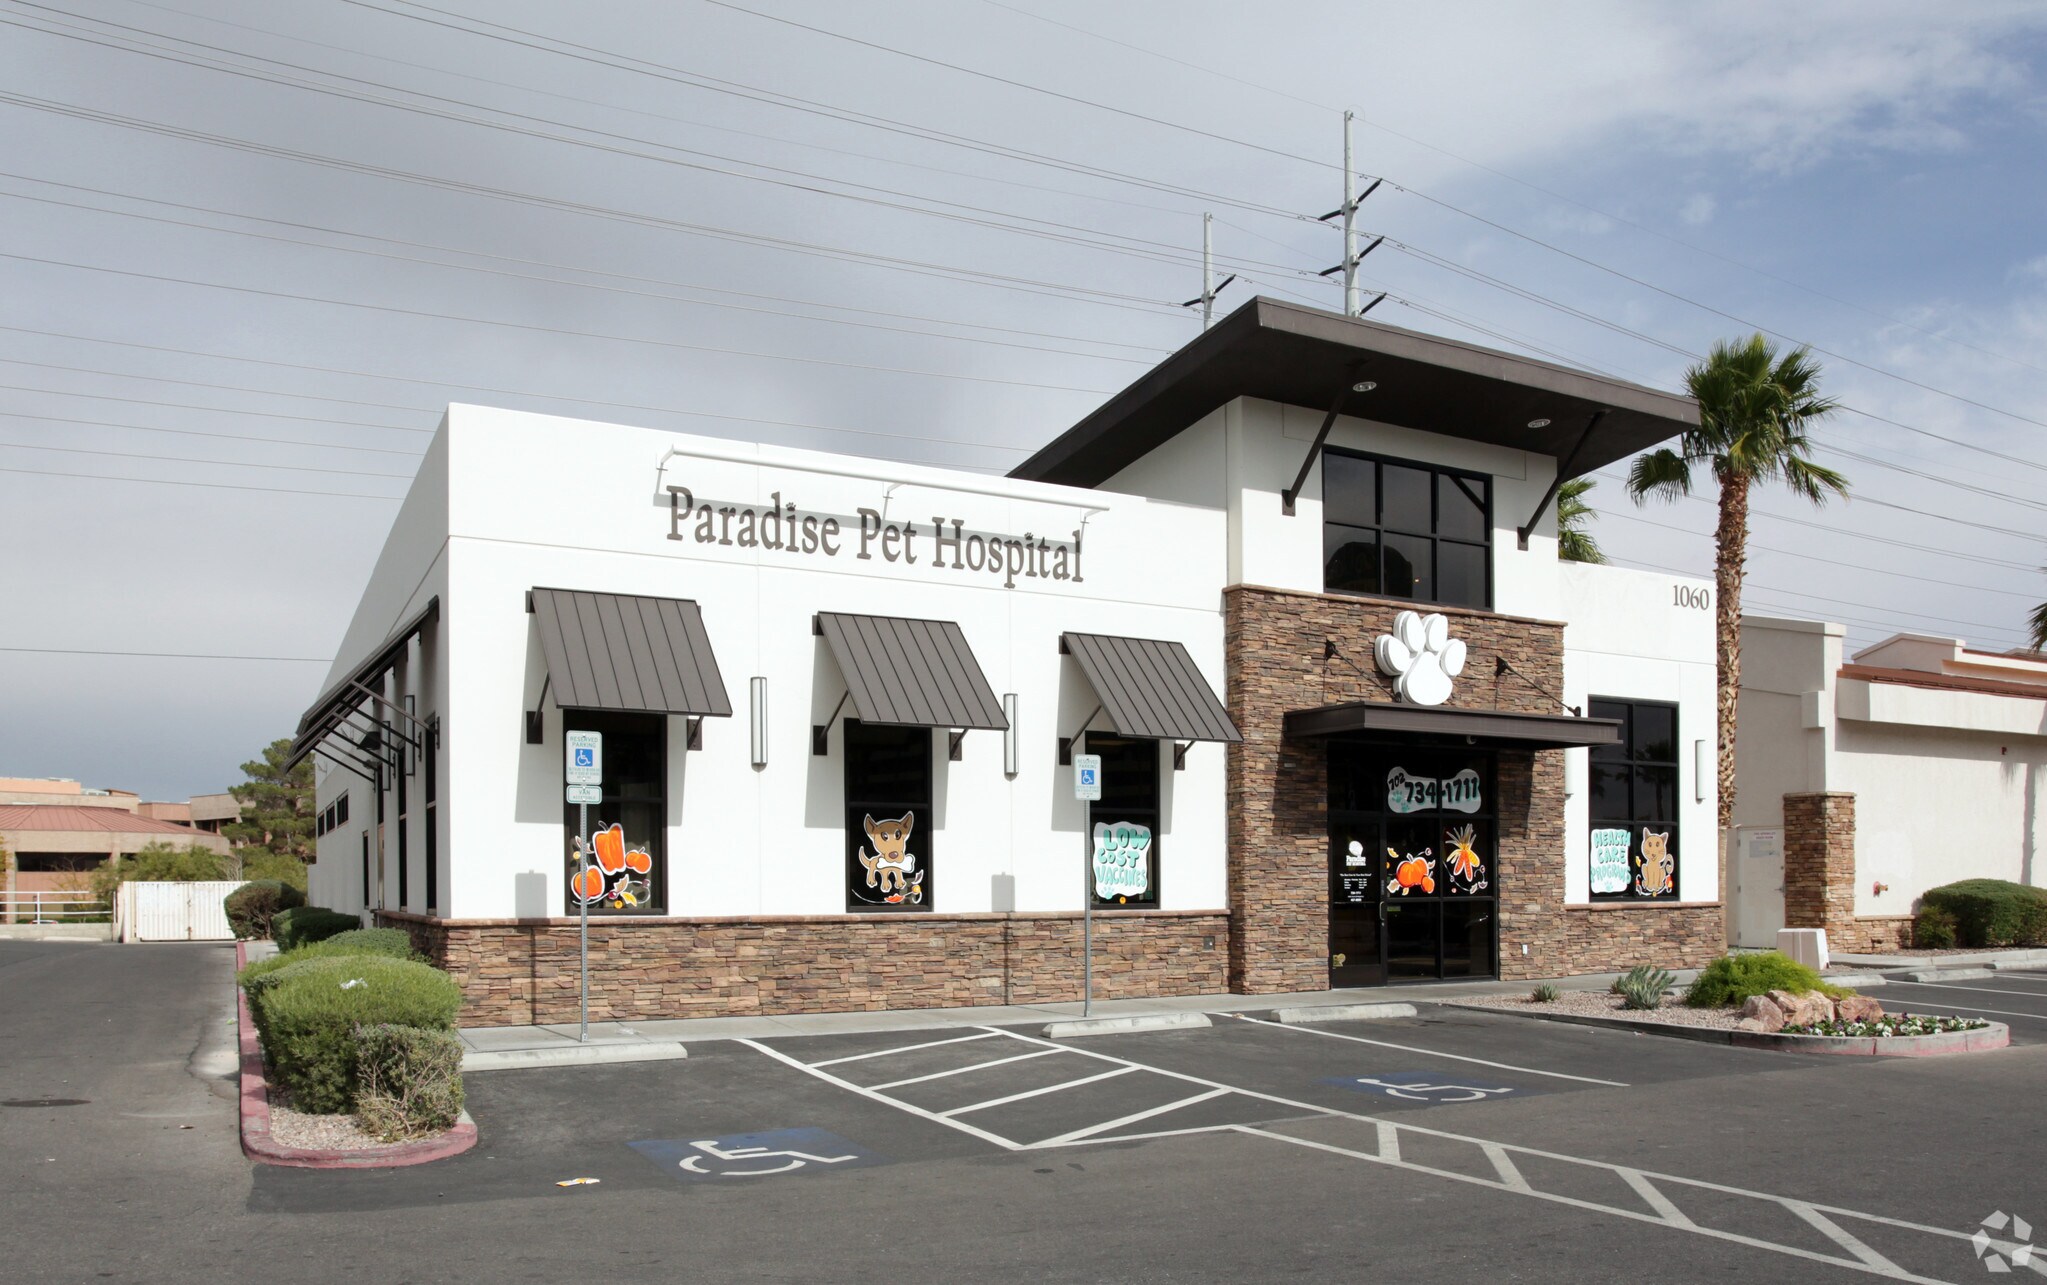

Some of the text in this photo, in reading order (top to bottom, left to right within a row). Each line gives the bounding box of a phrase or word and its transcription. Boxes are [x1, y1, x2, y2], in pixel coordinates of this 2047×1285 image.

[666, 485, 1084, 589] Paradise Pet Hospital
[1673, 584, 1710, 611] 1060
[1388, 772, 1405, 790] 702
[1103, 827, 1151, 851] LOW
[1594, 831, 1631, 848] HEALTH
[1097, 848, 1140, 869] COST
[1598, 847, 1627, 865] CARE
[1096, 865, 1147, 888] VACCINES
